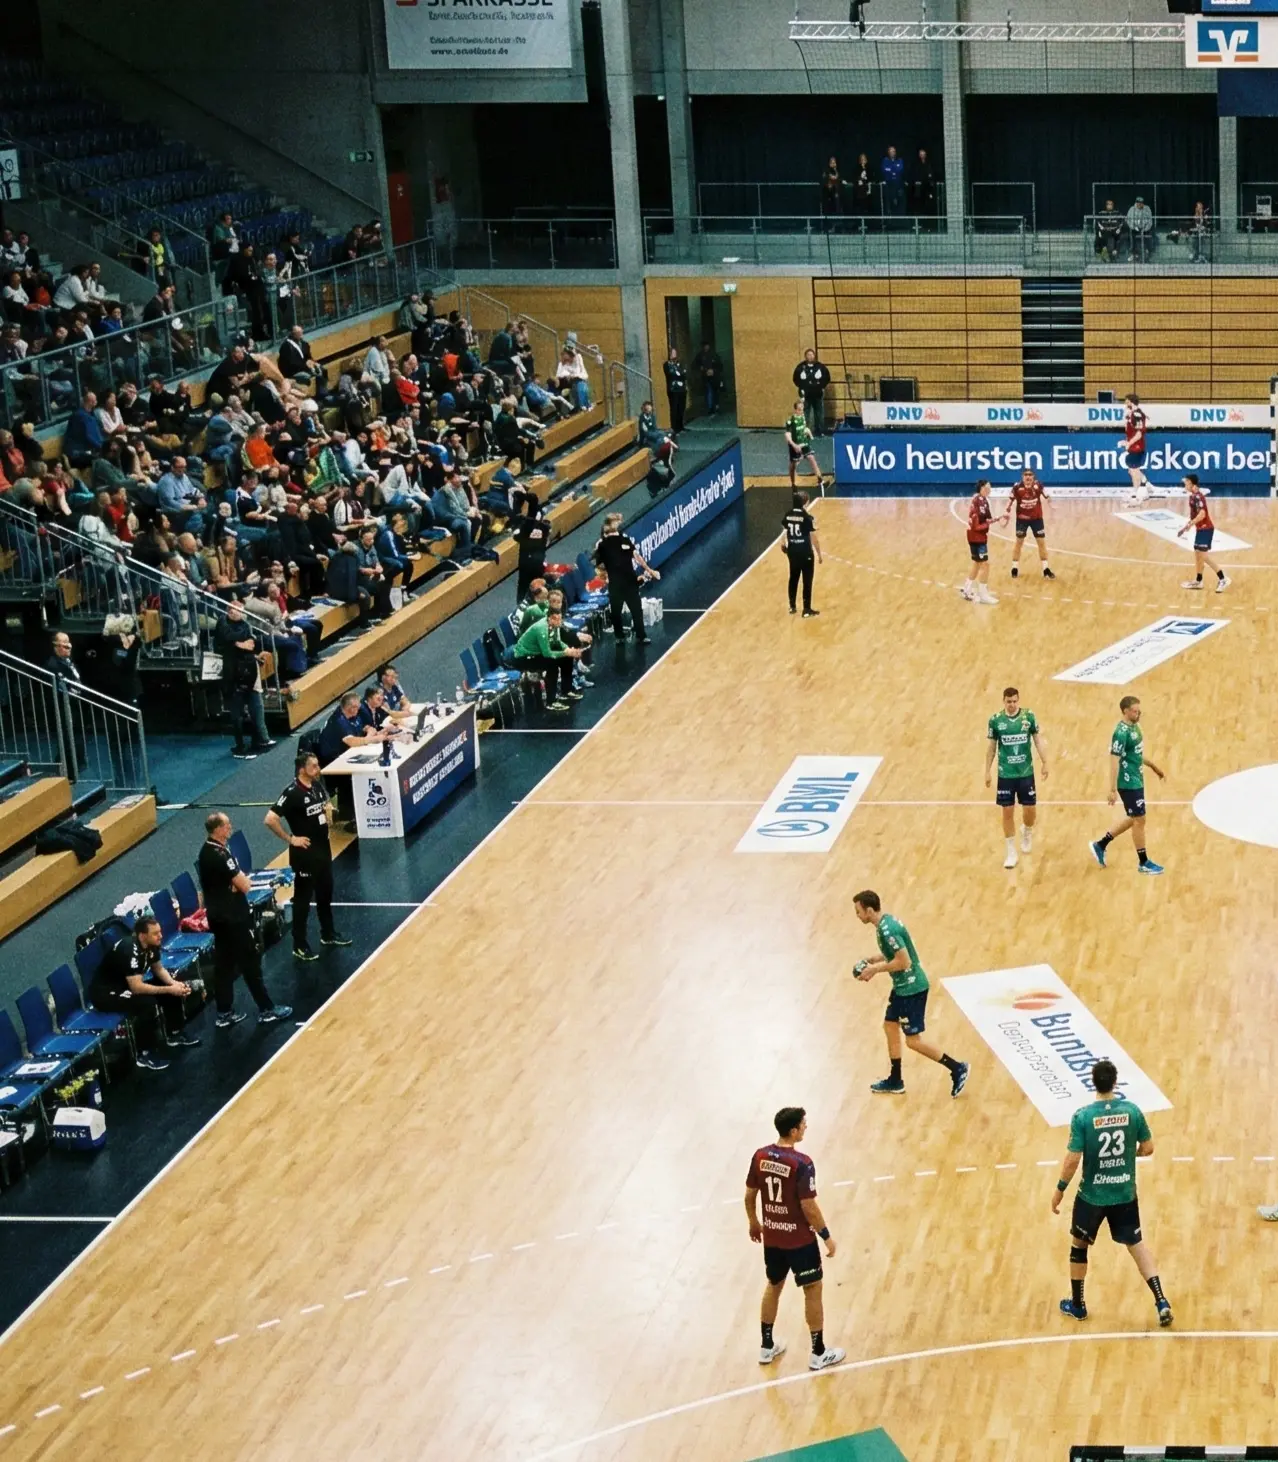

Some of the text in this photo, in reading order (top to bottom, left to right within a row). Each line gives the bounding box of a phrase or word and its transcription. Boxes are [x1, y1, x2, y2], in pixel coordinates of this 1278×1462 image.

[905, 443, 1043, 470] heursten
[774, 772, 860, 813] BML
[1098, 1130, 1126, 1158] 23
